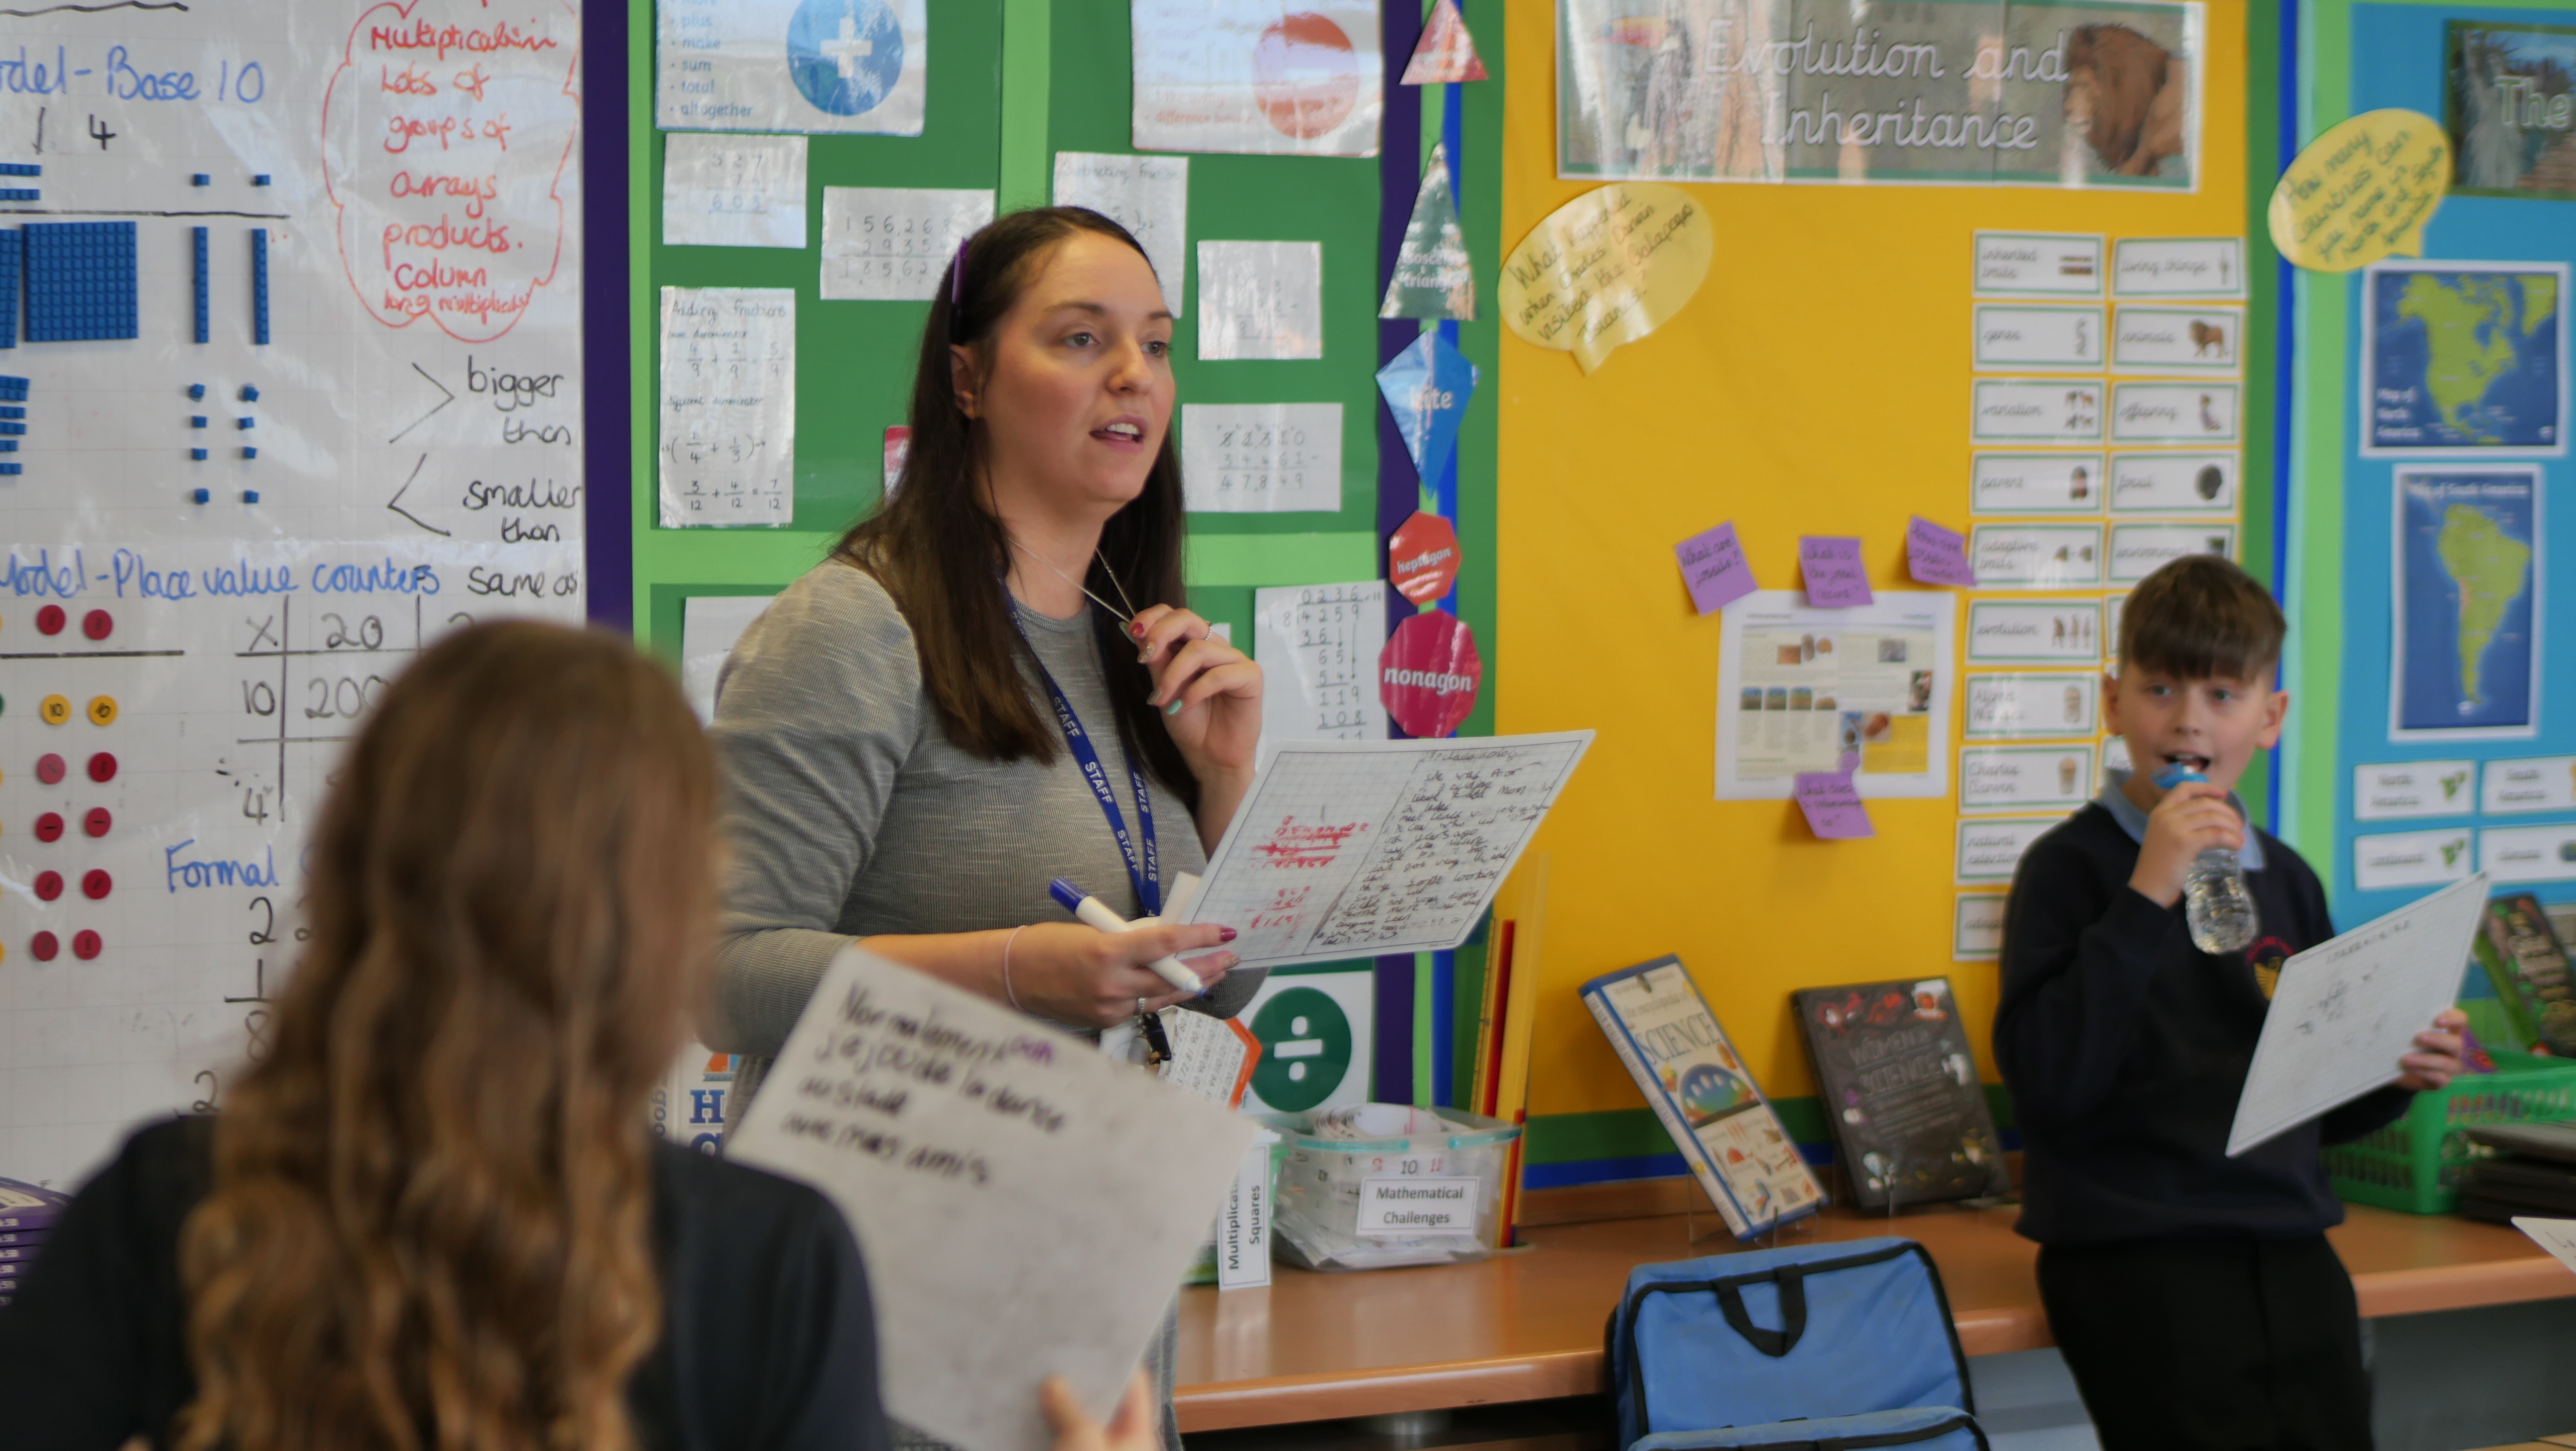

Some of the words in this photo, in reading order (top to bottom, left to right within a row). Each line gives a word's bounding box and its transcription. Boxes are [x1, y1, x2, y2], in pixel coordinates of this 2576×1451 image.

[683, 36, 721, 49] make
[1704, 20, 1945, 78] Evolution
[1962, 29, 2069, 83] and
[682, 60, 712, 72] sum
[681, 79, 715, 93] total
[681, 101, 753, 120] altogether
[2494, 76, 2572, 131] The
[1155, 110, 1211, 125] difference
[1762, 93, 2038, 149] Inheritance
[1980, 248, 2038, 262] inherited
[1507, 242, 1562, 290] What
[1519, 293, 1556, 326] when
[1537, 290, 1591, 341] visited
[1594, 263, 1625, 288] the
[1982, 329, 2022, 345] genes
[2119, 330, 2175, 344] animals
[468, 356, 564, 411] bigger
[1410, 385, 1453, 409] kite
[1981, 403, 2043, 416] variation
[2117, 403, 2178, 421] offspring
[464, 471, 582, 508] smaller
[1979, 475, 2024, 490] parent
[769, 498, 782, 510] 12
[501, 509, 560, 544] than
[1397, 547, 1451, 574] heptagon
[201, 559, 298, 595] value
[323, 614, 383, 651] 20
[1976, 621, 2038, 636] evolution
[1384, 667, 1472, 696] nonagon
[242, 679, 276, 716] 10
[1052, 696, 1081, 738] STAFF
[1967, 762, 2019, 777] Charles
[1085, 761, 1114, 805] STAFF
[1968, 780, 2015, 794] Darwin
[1133, 772, 1148, 813] STAFF
[1965, 832, 2015, 847] natural
[1117, 829, 1139, 872] STAFF
[166, 838, 279, 894] Formal
[1147, 838, 1157, 882] STAFF
[1189, 1032, 1199, 1044] 90
[1205, 1030, 1216, 1043] 110
[1634, 1012, 1722, 1066] SCIENCE
[1185, 1049, 1195, 1060] 81
[1201, 1045, 1211, 1058] 100
[1179, 1063, 1189, 1075] 72
[1196, 1061, 1206, 1073] 90
[1212, 1059, 1223, 1072] 110
[1858, 1052, 1941, 1095] SCIENCE
[1190, 1076, 1201, 1089] 80
[1208, 1074, 1217, 1087] 99
[1223, 1072, 1234, 1085] 120
[1651, 1097, 1674, 1126] SCIENCE
[1400, 1160, 1418, 1175] 10
[1376, 1187, 1463, 1200] Mathematical
[1249, 1185, 1262, 1245] Squares
[1383, 1210, 1450, 1226] Challenges
